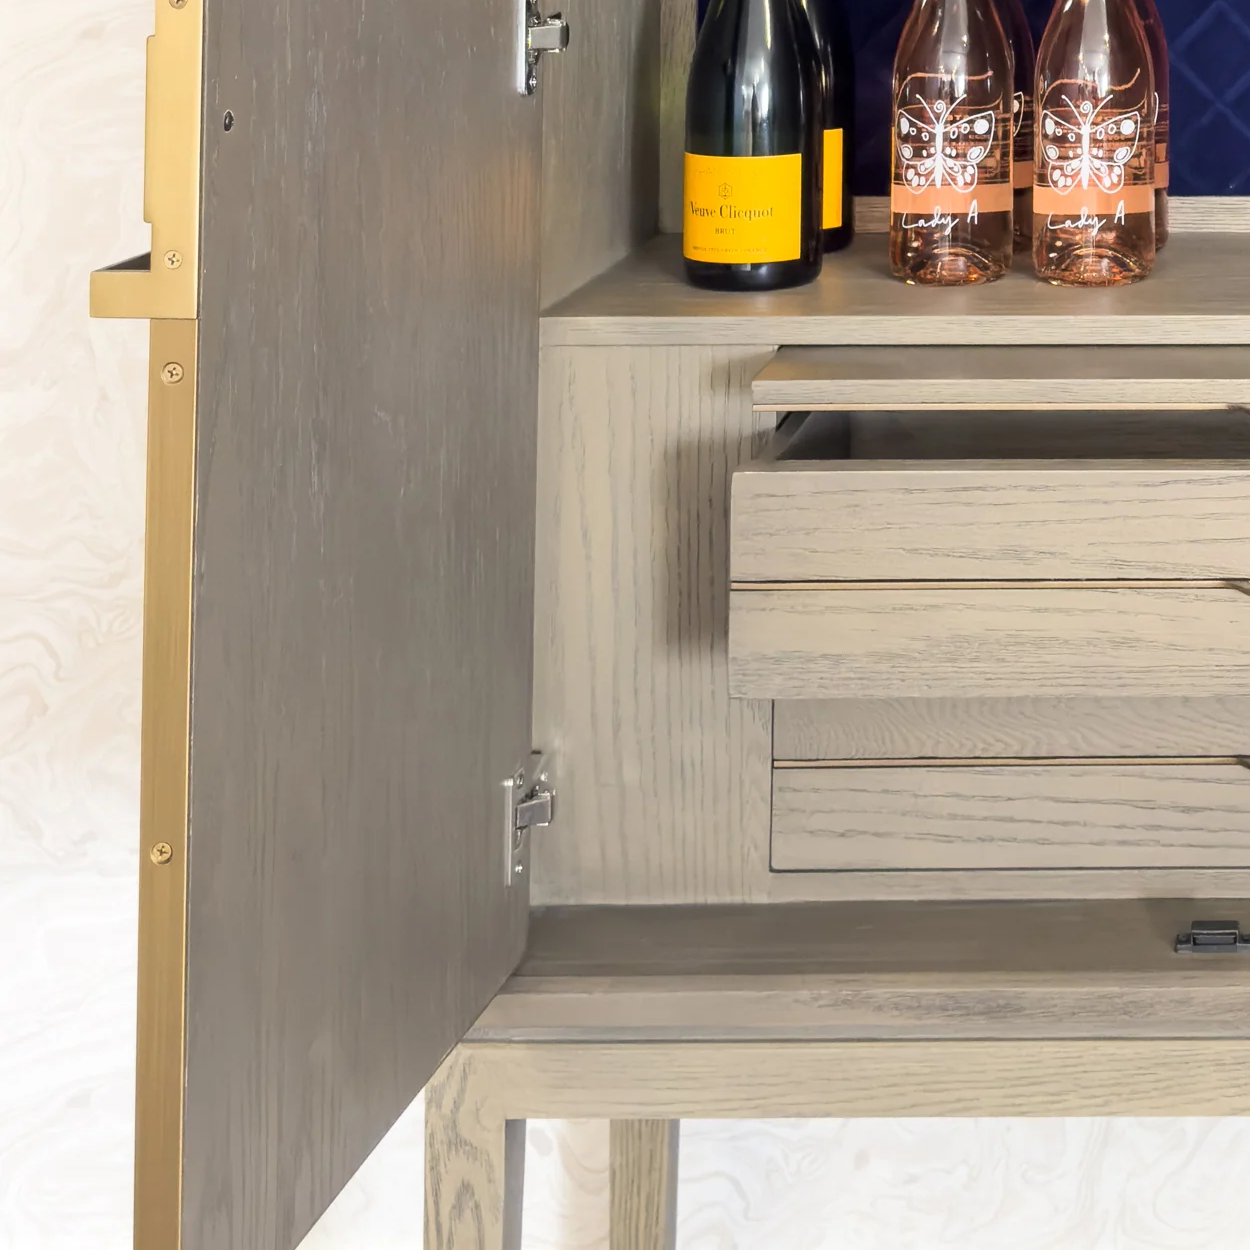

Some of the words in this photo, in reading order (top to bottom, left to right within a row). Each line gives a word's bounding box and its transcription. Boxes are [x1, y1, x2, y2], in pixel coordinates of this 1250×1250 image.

[690, 201, 716, 218] Veuve
[719, 204, 773, 221] Clicquot
[902, 206, 959, 235] Lady
[967, 199, 978, 225] A
[1048, 206, 1106, 236] Lady
[1114, 200, 1125, 225] A
[714, 227, 735, 235] BRUT
